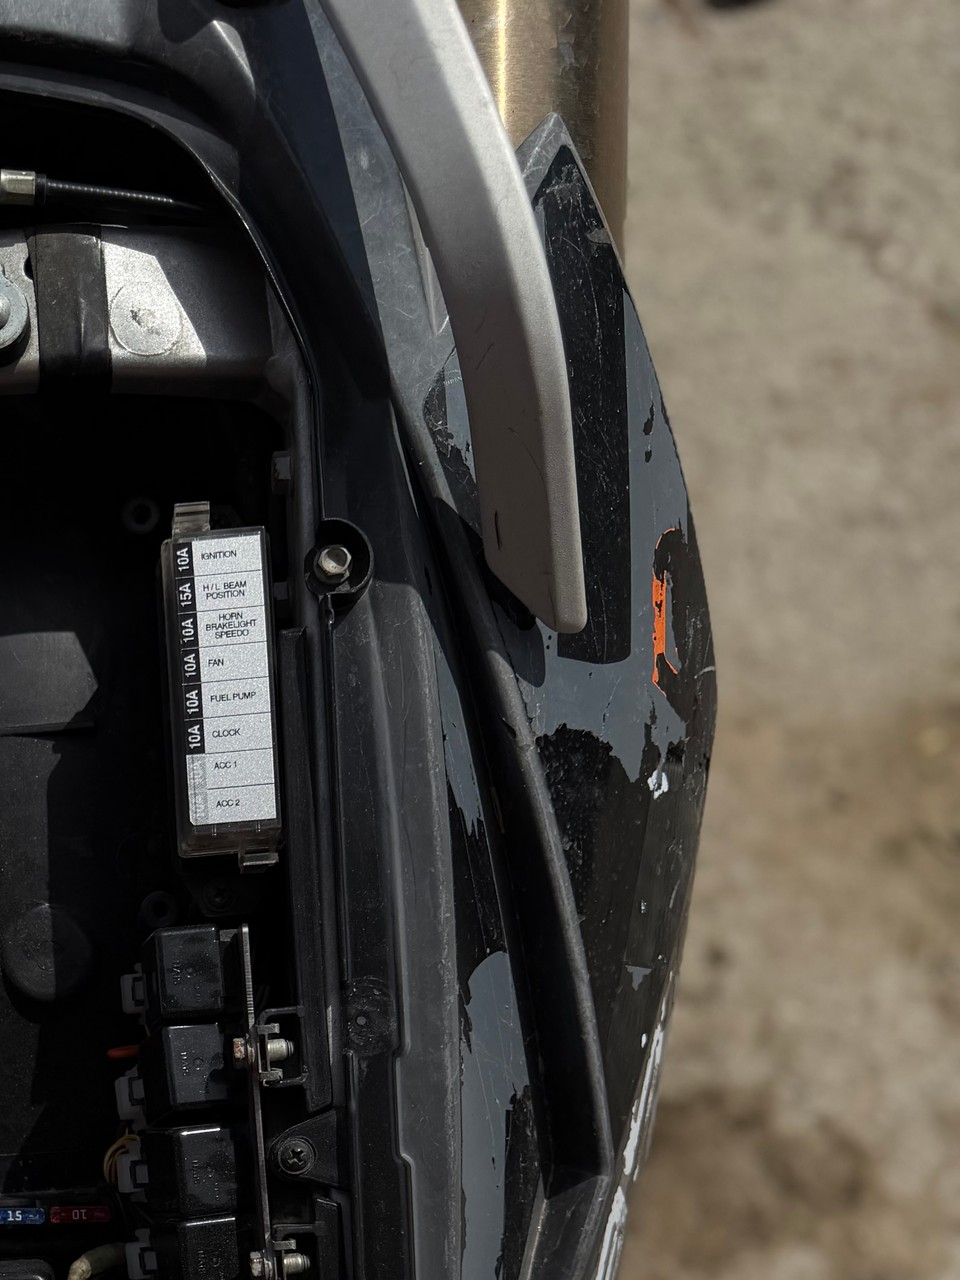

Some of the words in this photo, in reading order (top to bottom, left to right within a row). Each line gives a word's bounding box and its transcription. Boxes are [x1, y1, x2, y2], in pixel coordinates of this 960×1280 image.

[177, 548, 190, 572] 10A
[201, 550, 237, 560] IGNITION
[223, 581, 247, 590] BEAM
[179, 583, 192, 607] 15A
[206, 590, 245, 600] POSITION
[218, 612, 243, 622] HORN
[182, 618, 195, 643] 10A
[205, 619, 257, 631] BRAKELIGHT
[215, 629, 249, 639] SPEEDO
[184, 653, 197, 678] 10A
[208, 659, 224, 667] FAN
[186, 689, 199, 714] 10A
[210, 693, 232, 703] FUEL
[233, 691, 257, 701] PUMP
[188, 724, 201, 749] 10A
[212, 728, 241, 738] CLOCK
[214, 761, 232, 770] ACC
[215, 800, 233, 808] ACC
[234, 799, 240, 807] 2
[7, 1210, 22, 1221] 15
[72, 1209, 87, 1220] 10
